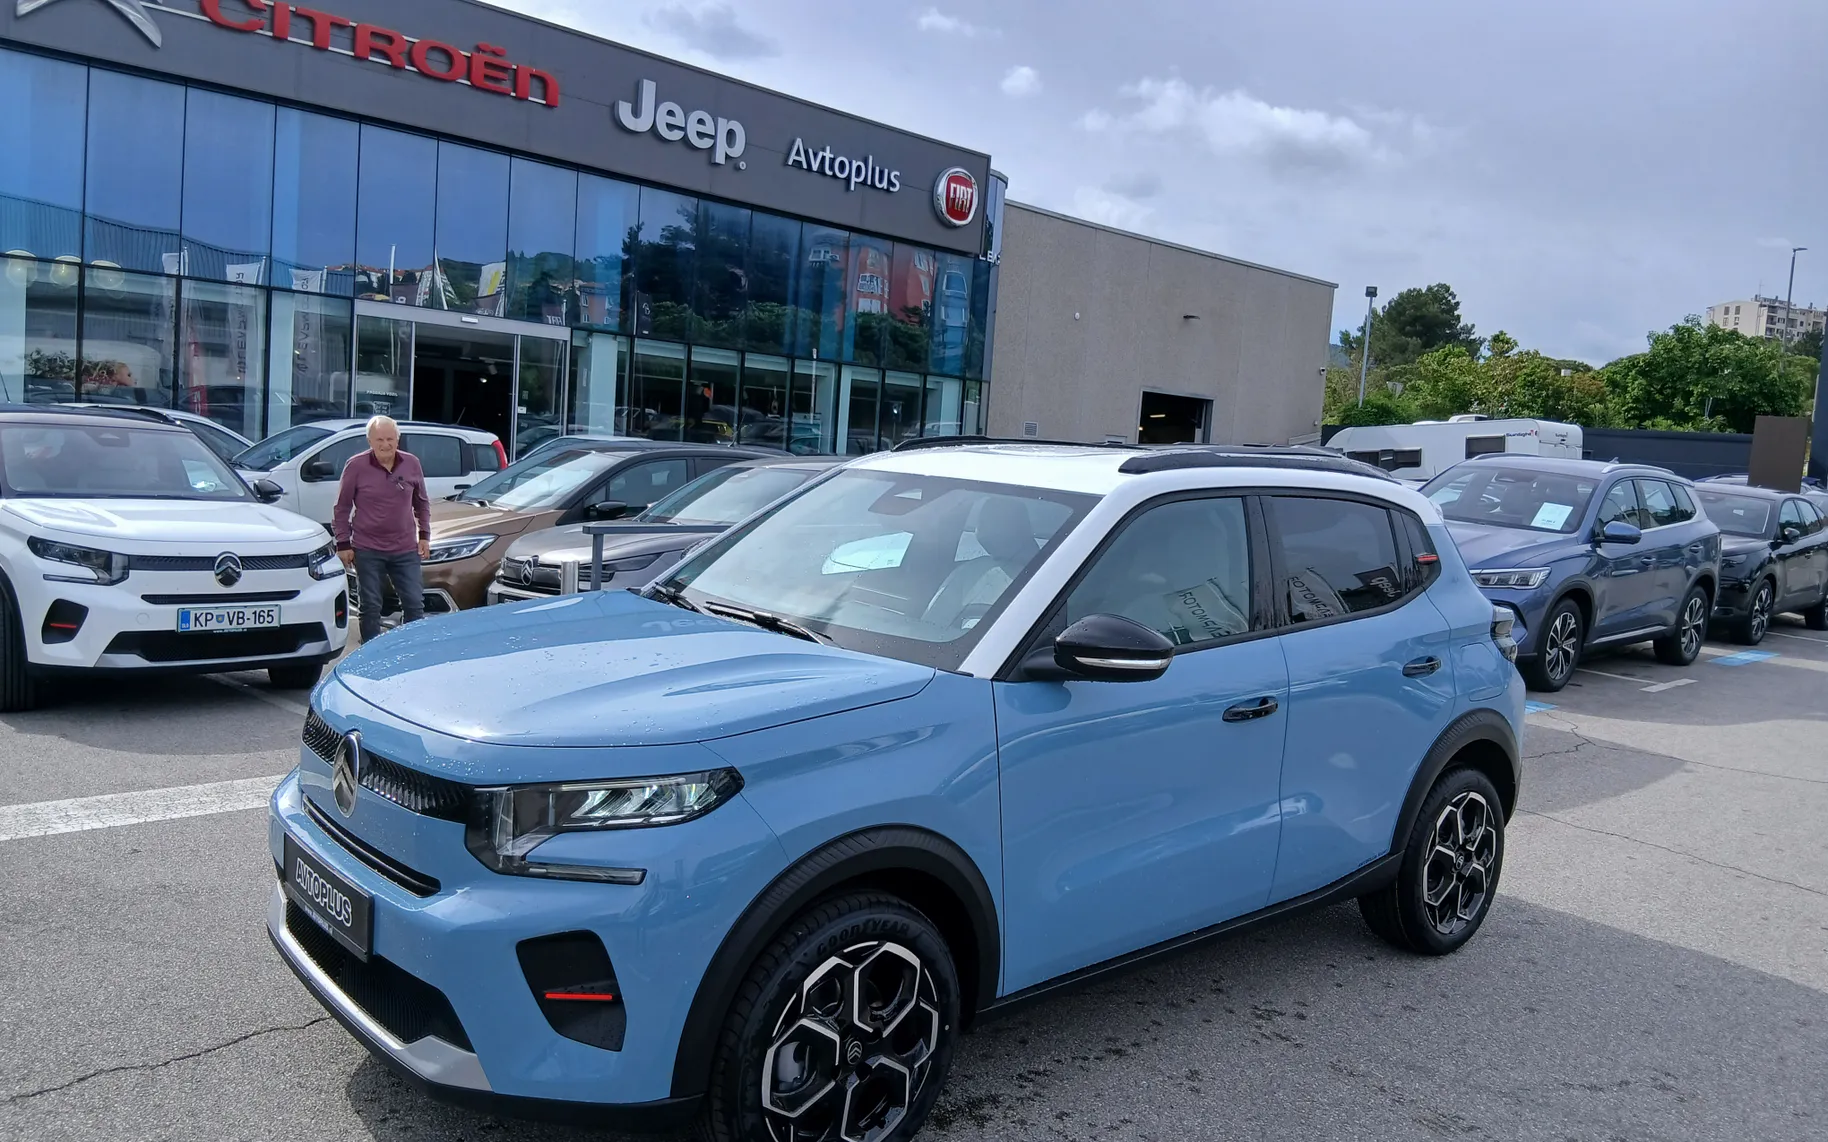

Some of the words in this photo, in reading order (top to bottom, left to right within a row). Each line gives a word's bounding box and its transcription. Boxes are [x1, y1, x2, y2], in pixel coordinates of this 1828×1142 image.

[614, 79, 746, 165] Jeep
[786, 137, 901, 192] Avtoplus
[949, 182, 973, 213] FIAT
[194, 612, 214, 628] KP
[226, 609, 275, 626] VB-165
[295, 857, 352, 927] AVTOPLUS
